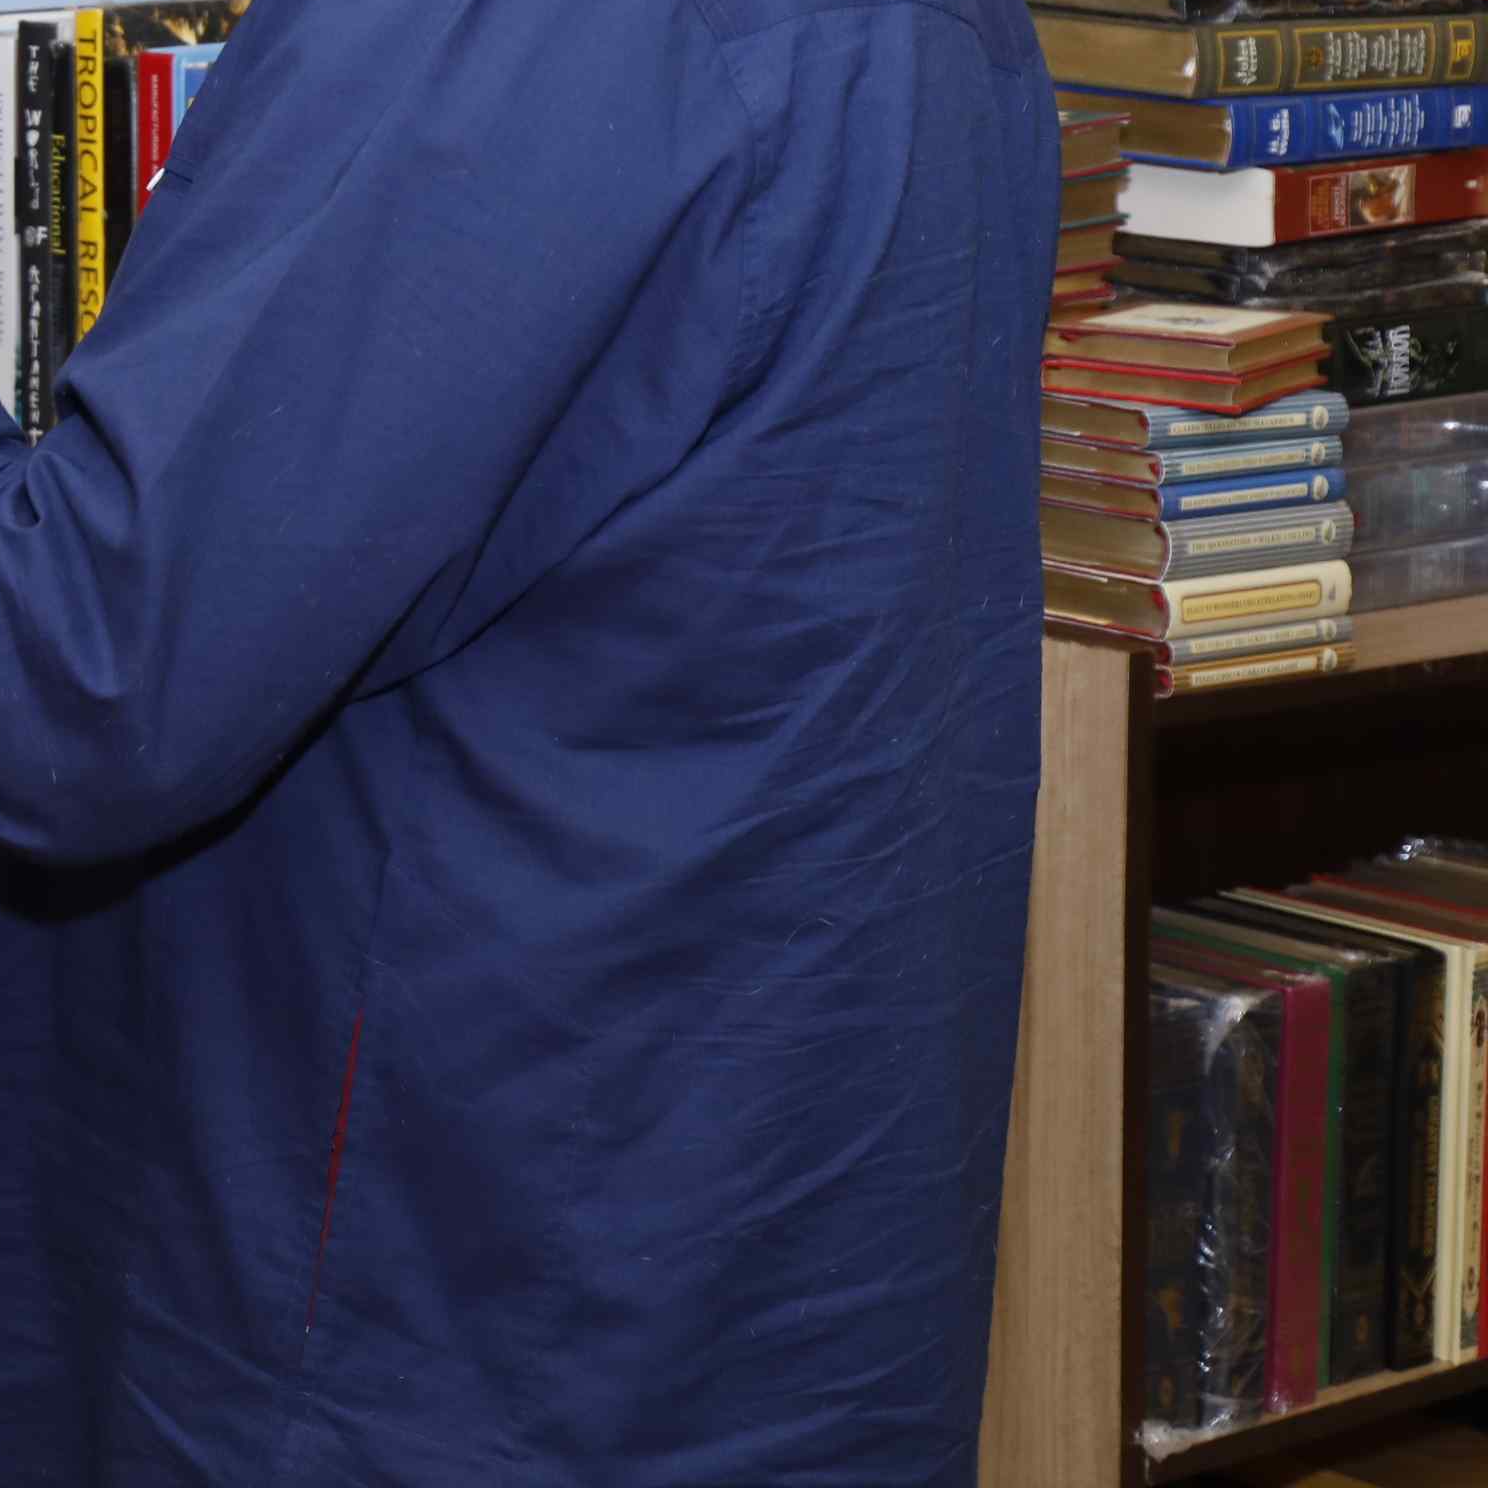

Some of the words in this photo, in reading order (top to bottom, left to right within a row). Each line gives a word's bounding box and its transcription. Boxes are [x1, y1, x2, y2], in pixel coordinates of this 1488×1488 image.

[1236, 39, 1248, 80] Jules
[1245, 36, 1258, 86] Verne
[77, 29, 98, 223] TROPICAL
[51, 133, 66, 255] Educational
[1386, 324, 1411, 397] HORROR
